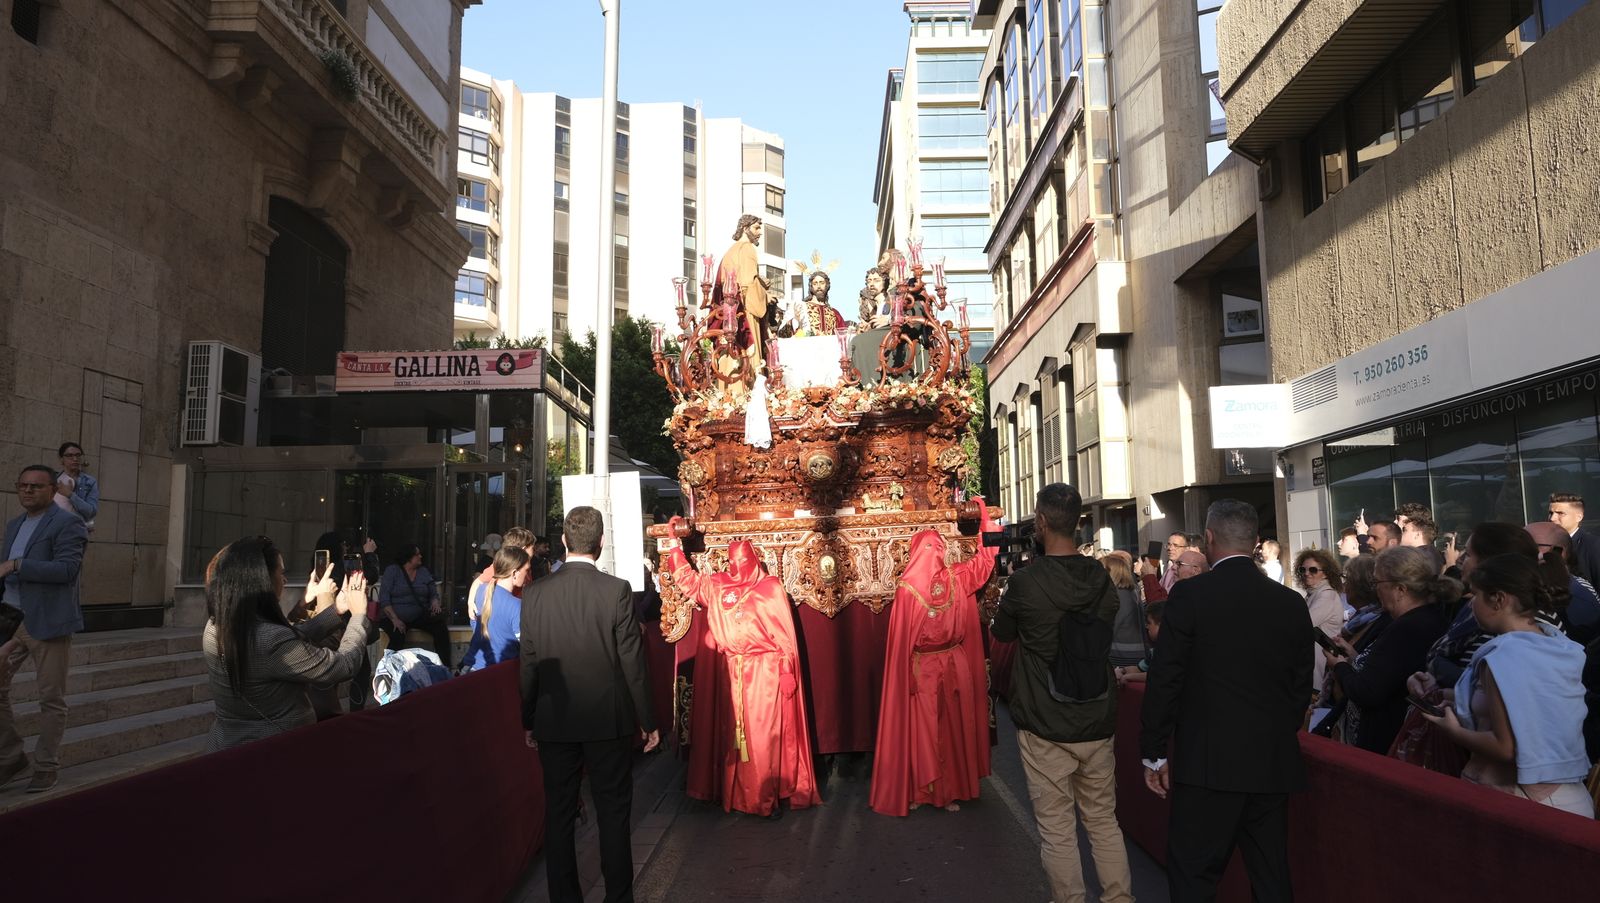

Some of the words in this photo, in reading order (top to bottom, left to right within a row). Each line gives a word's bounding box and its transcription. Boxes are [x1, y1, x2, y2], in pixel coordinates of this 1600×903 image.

[347, 362, 371, 372] CANTA
[374, 363, 384, 372] LA
[395, 355, 482, 378] GALLINA
[1364, 363, 1383, 382] 950
[1385, 353, 1405, 374] 260
[1407, 344, 1428, 366] 356
[1534, 373, 1600, 404] TEMPO
[1224, 399, 1279, 412] Zamora
